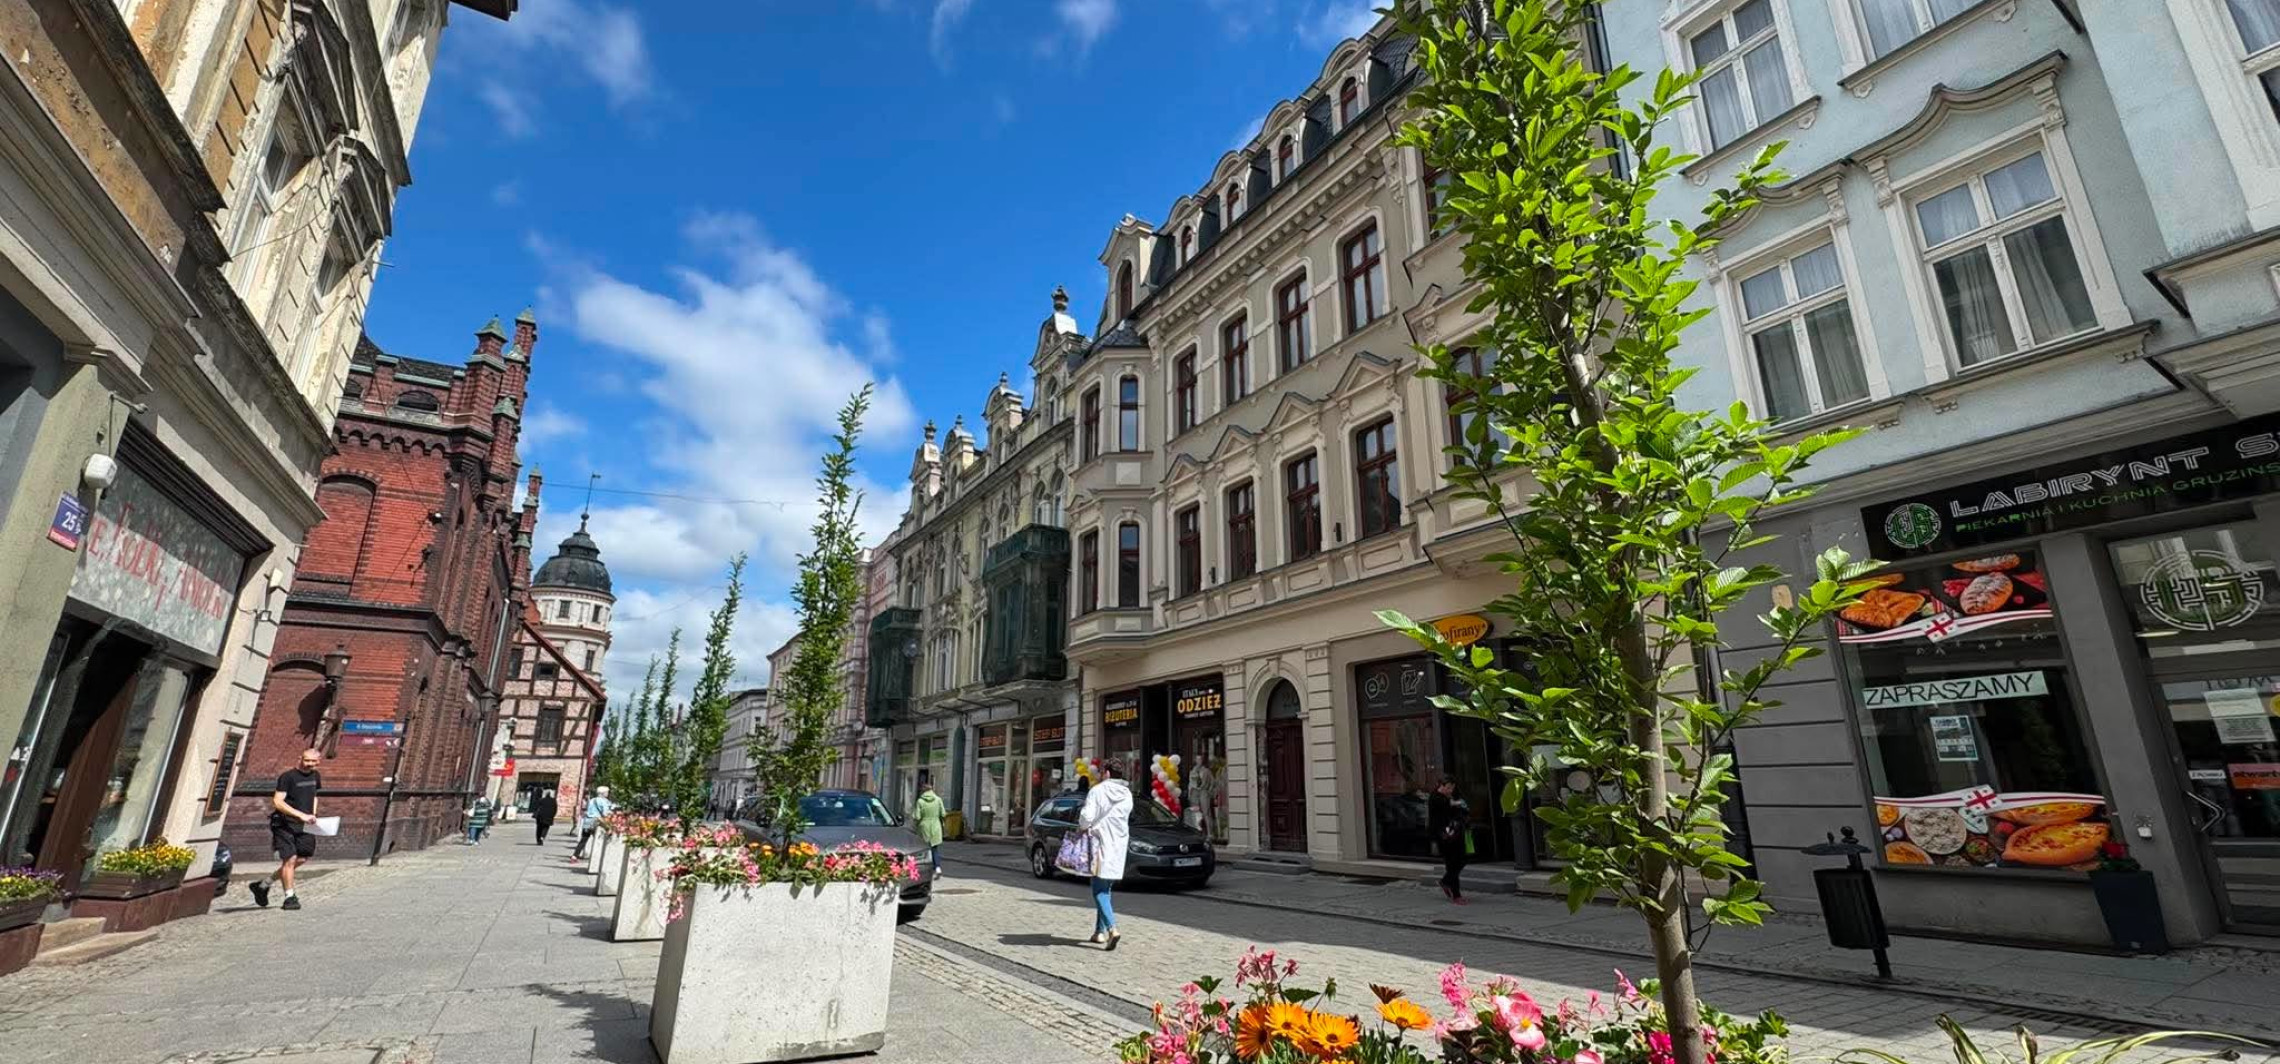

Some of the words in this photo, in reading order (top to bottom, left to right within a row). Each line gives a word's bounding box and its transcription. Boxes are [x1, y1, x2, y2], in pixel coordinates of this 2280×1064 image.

[1949, 446, 2210, 518] LABIRYNT
[2235, 433, 2280, 460] S
[61, 511, 78, 531] 25
[1956, 505, 2055, 533] PIEKARNIA
[2069, 486, 2167, 512] KUCHNIA
[1863, 673, 2034, 706] ZAPRASZAMY
